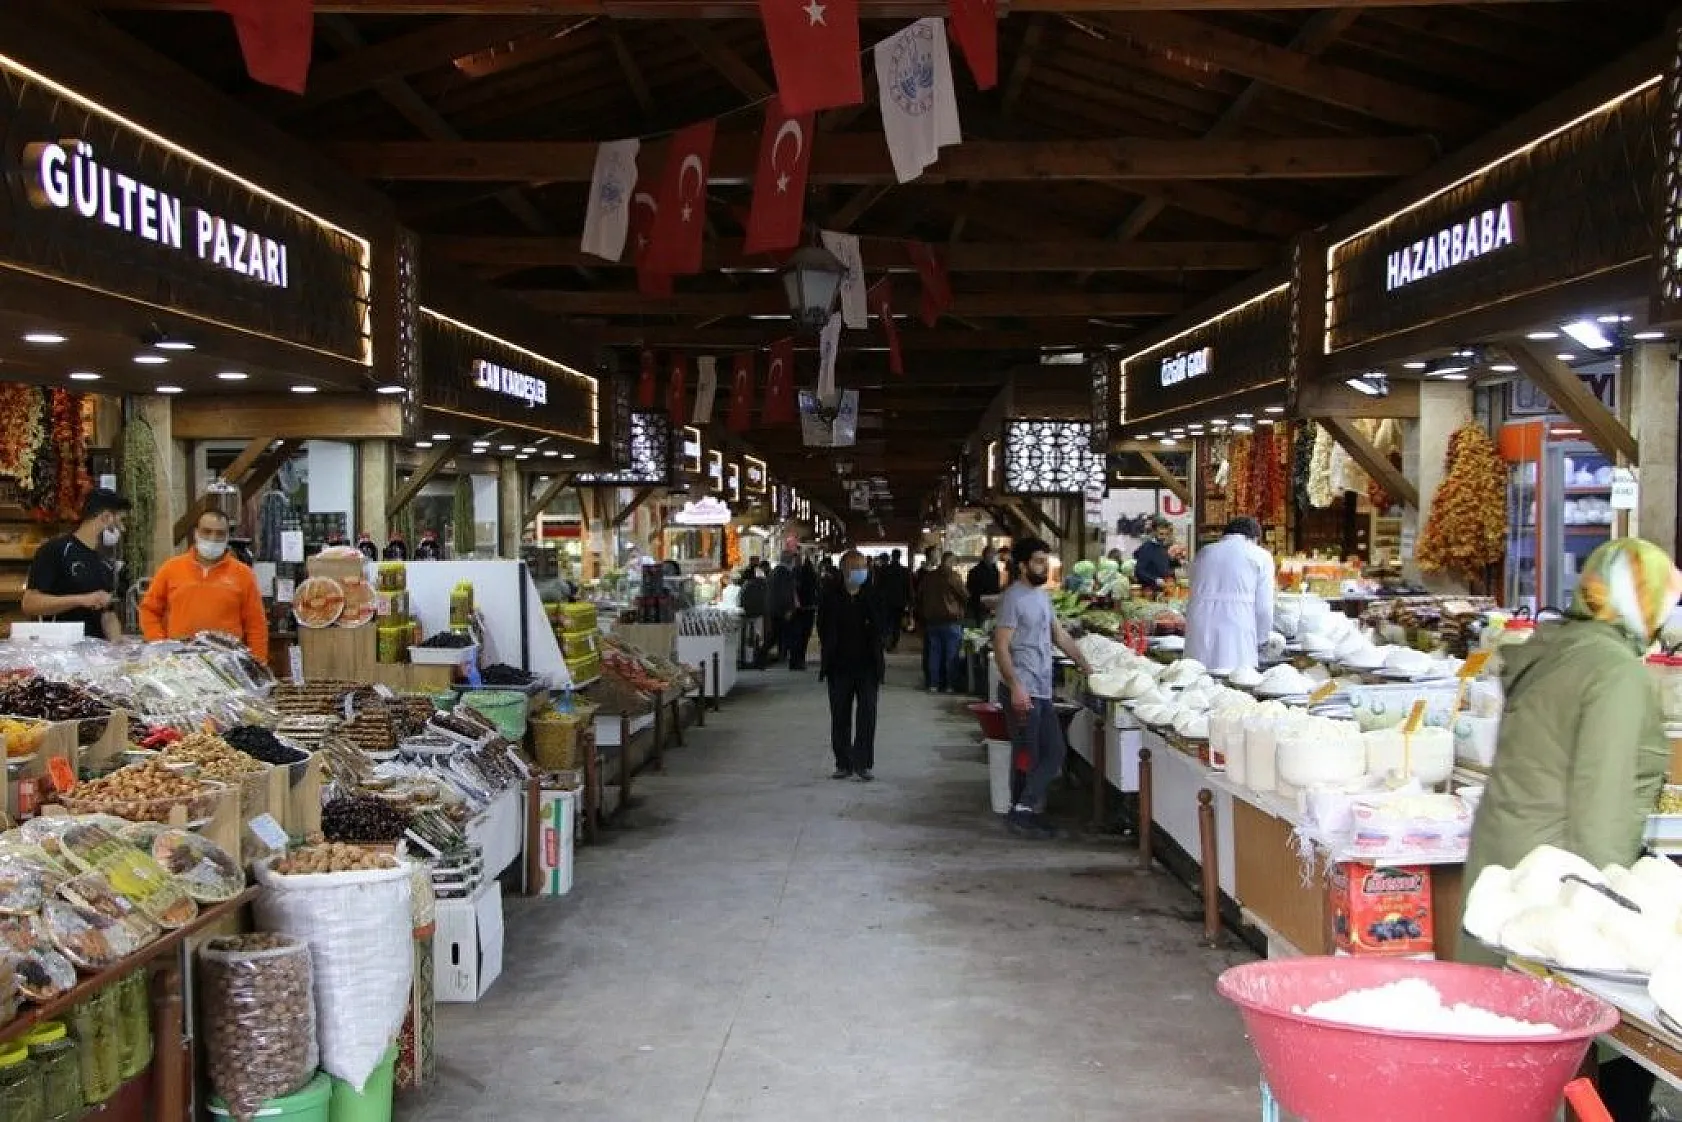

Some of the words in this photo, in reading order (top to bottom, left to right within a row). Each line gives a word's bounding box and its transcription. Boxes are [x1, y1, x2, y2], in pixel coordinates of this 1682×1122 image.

[40, 140, 182, 249] GÜLTEN
[196, 208, 288, 289] PAZARI
[1386, 201, 1513, 292] HAZARBABA
